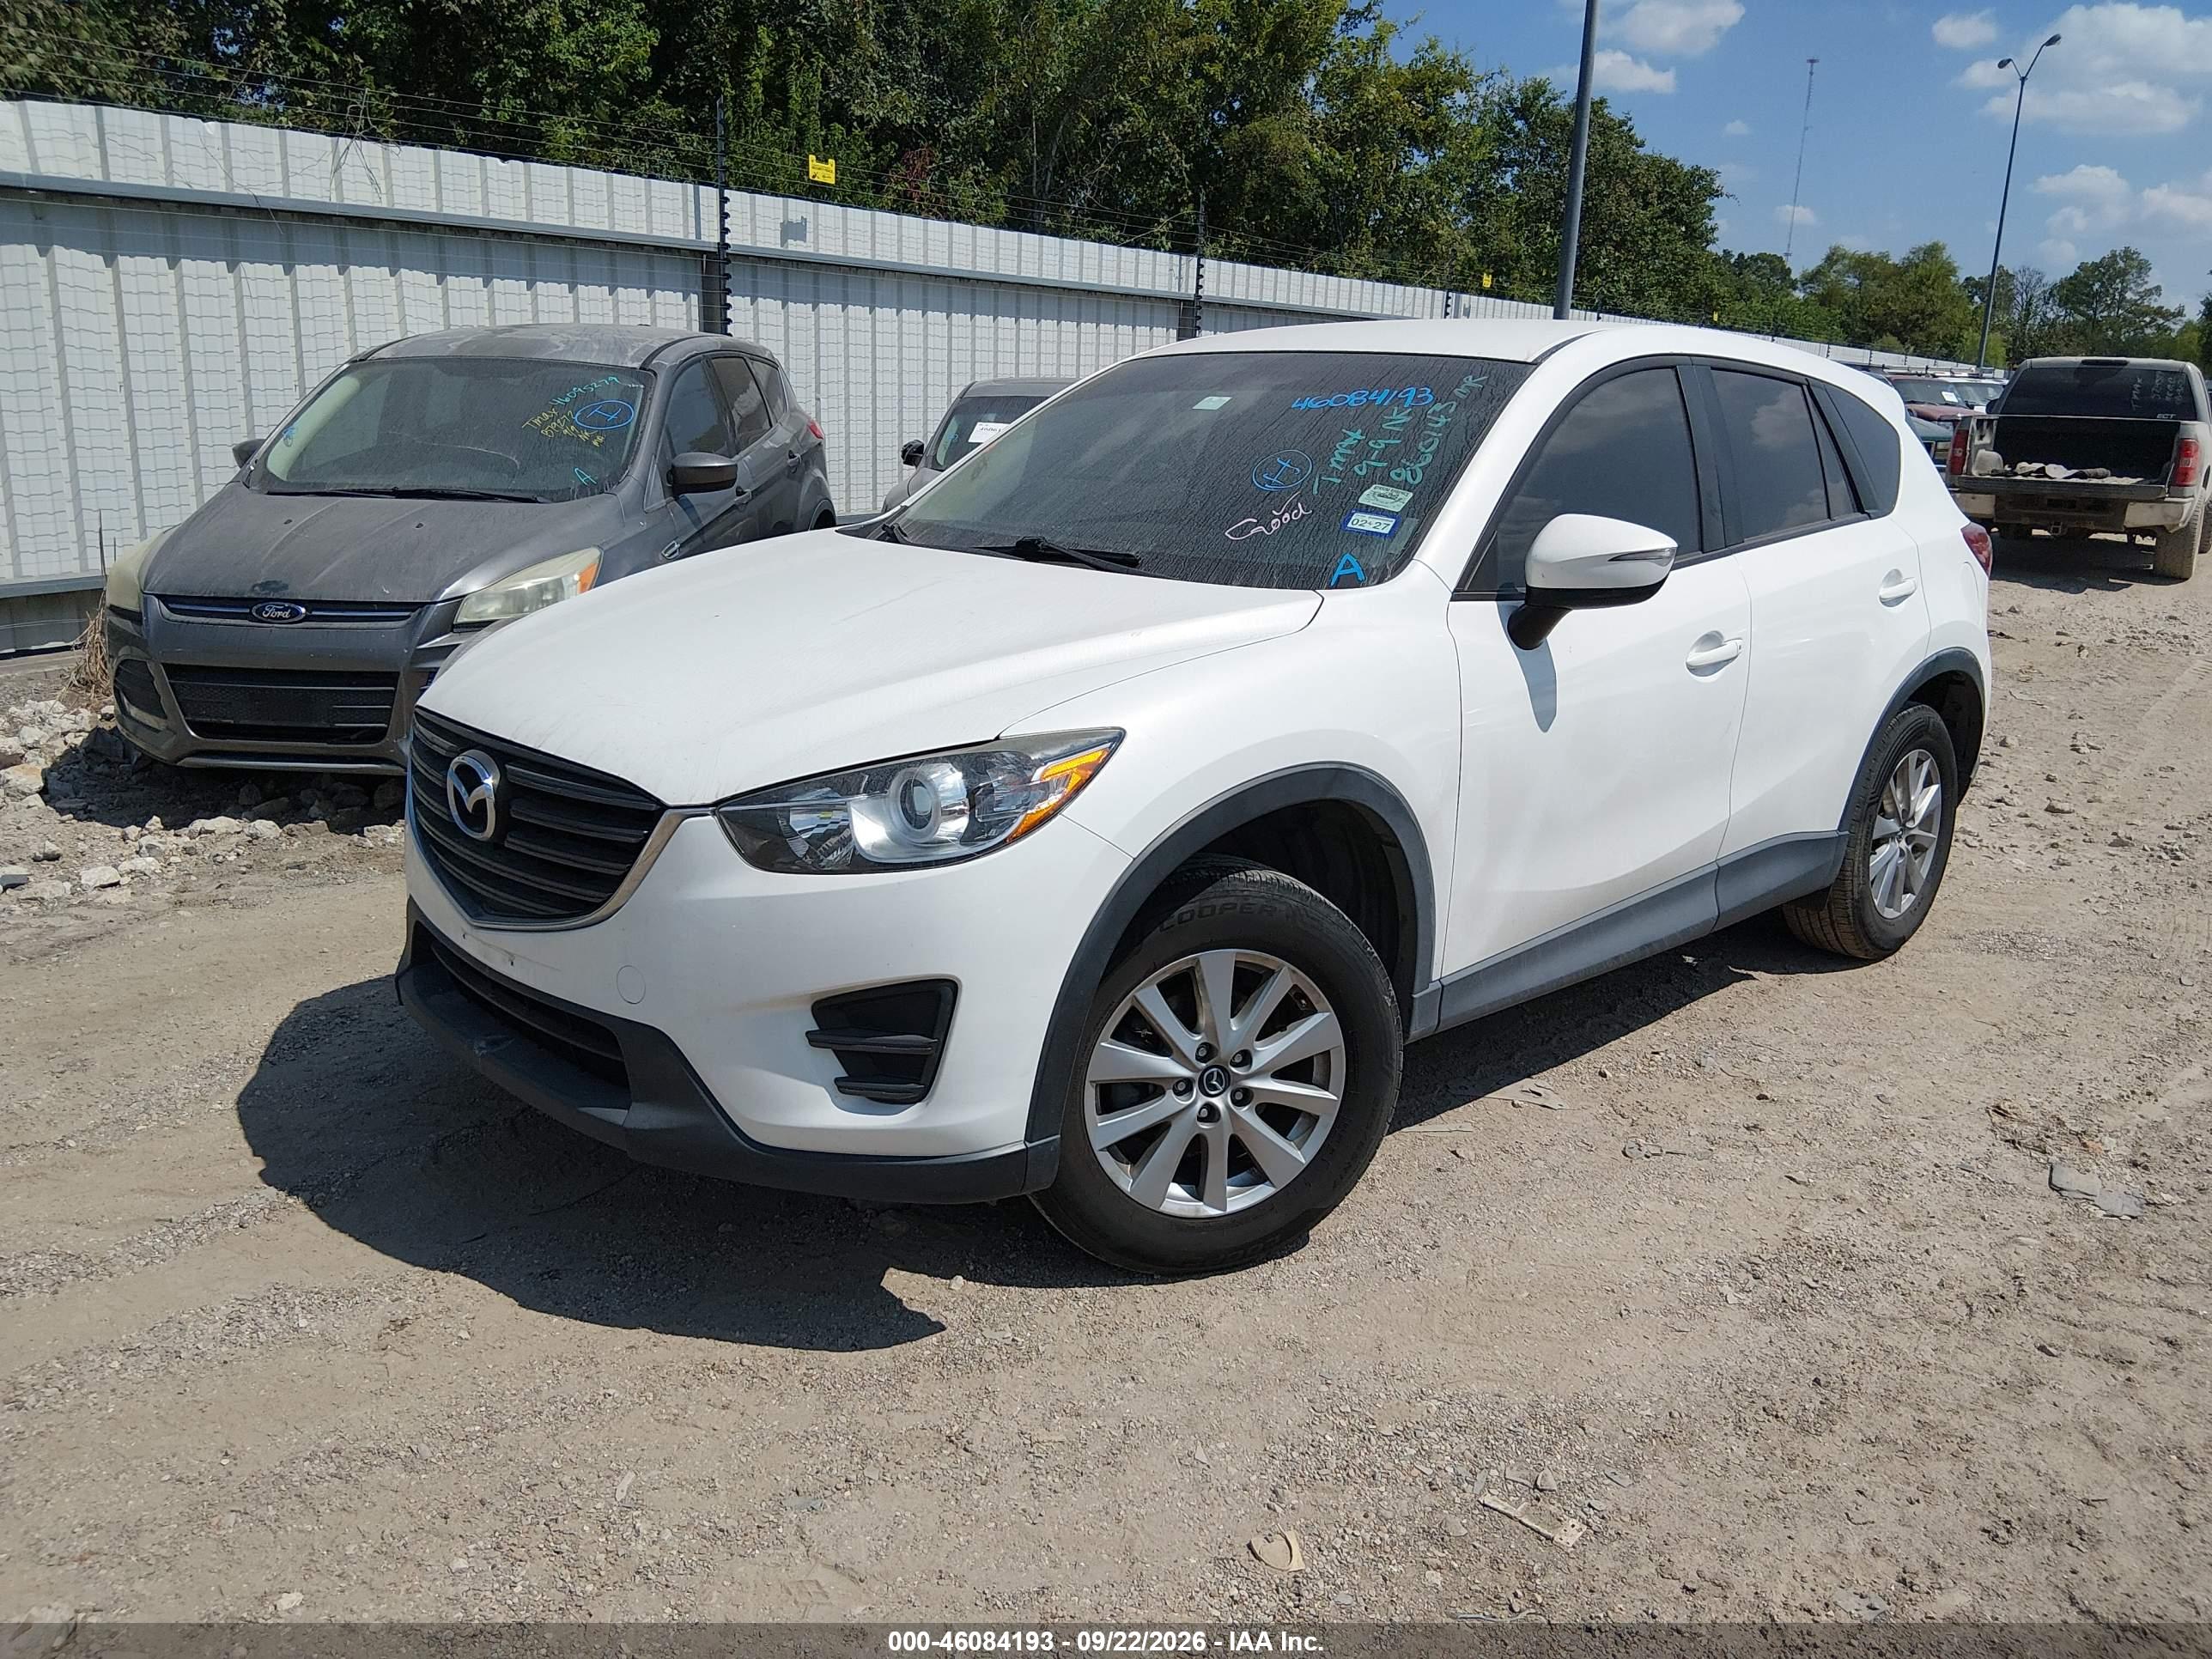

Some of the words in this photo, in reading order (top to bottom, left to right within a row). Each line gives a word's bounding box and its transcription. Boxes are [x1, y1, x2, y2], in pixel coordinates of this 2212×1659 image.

[1291, 386, 1435, 410] 46084193
[1351, 518, 1368, 527] 02
[1372, 521, 1391, 531] 27
[1330, 553, 1366, 586] A
[262, 604, 291, 618] Ford
[1158, 901, 1279, 933] COOPER
